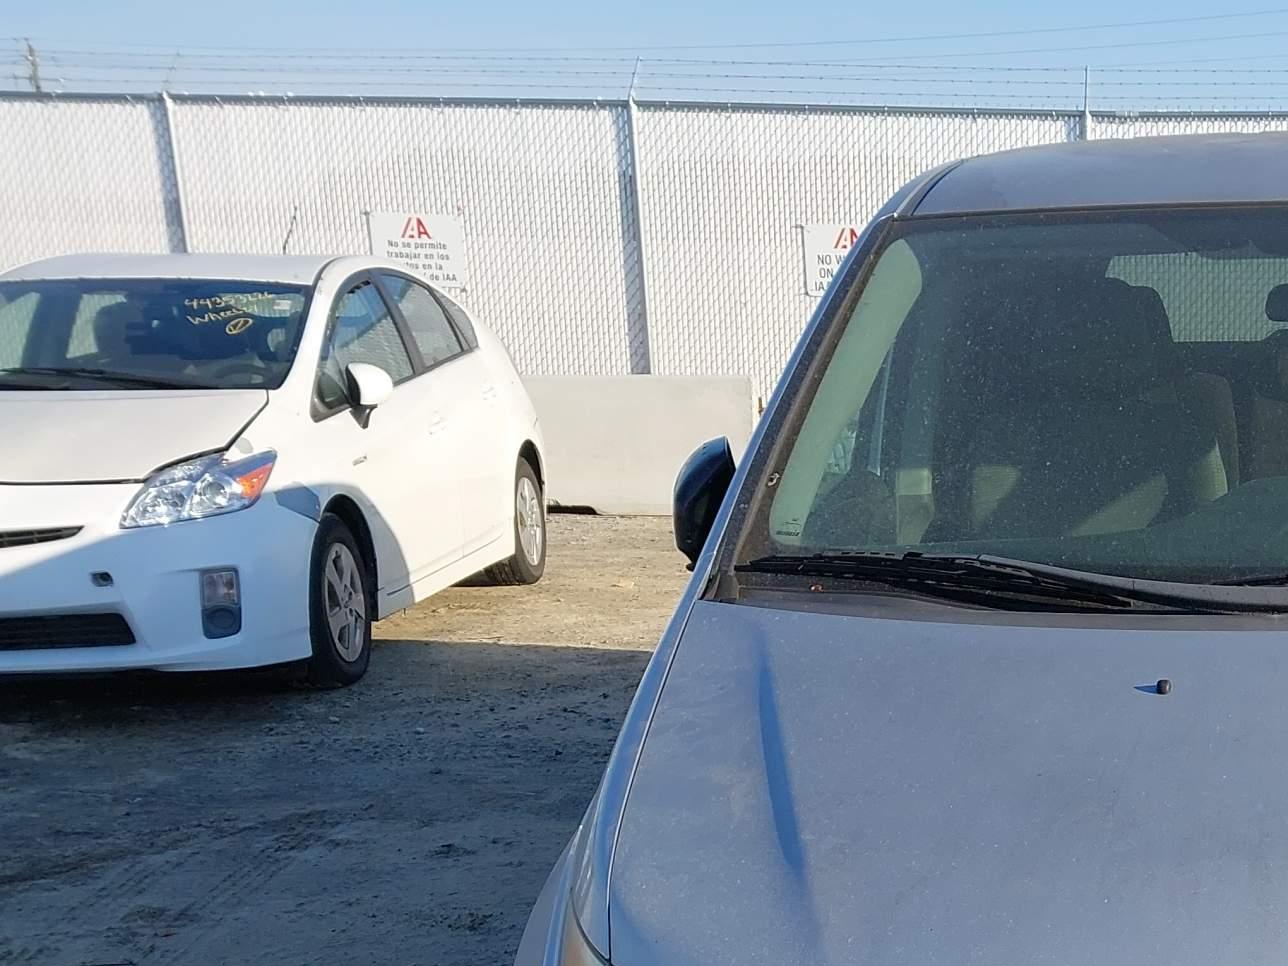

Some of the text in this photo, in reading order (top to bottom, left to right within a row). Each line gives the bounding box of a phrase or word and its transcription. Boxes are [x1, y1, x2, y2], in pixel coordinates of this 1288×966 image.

[387, 239, 447, 250] No se permite
[386, 250, 450, 261] trabajar en los
[817, 254, 832, 266] NO
[422, 262, 433, 270] en
[435, 262, 443, 271] la
[429, 272, 440, 281] de
[442, 273, 457, 282] IAA
